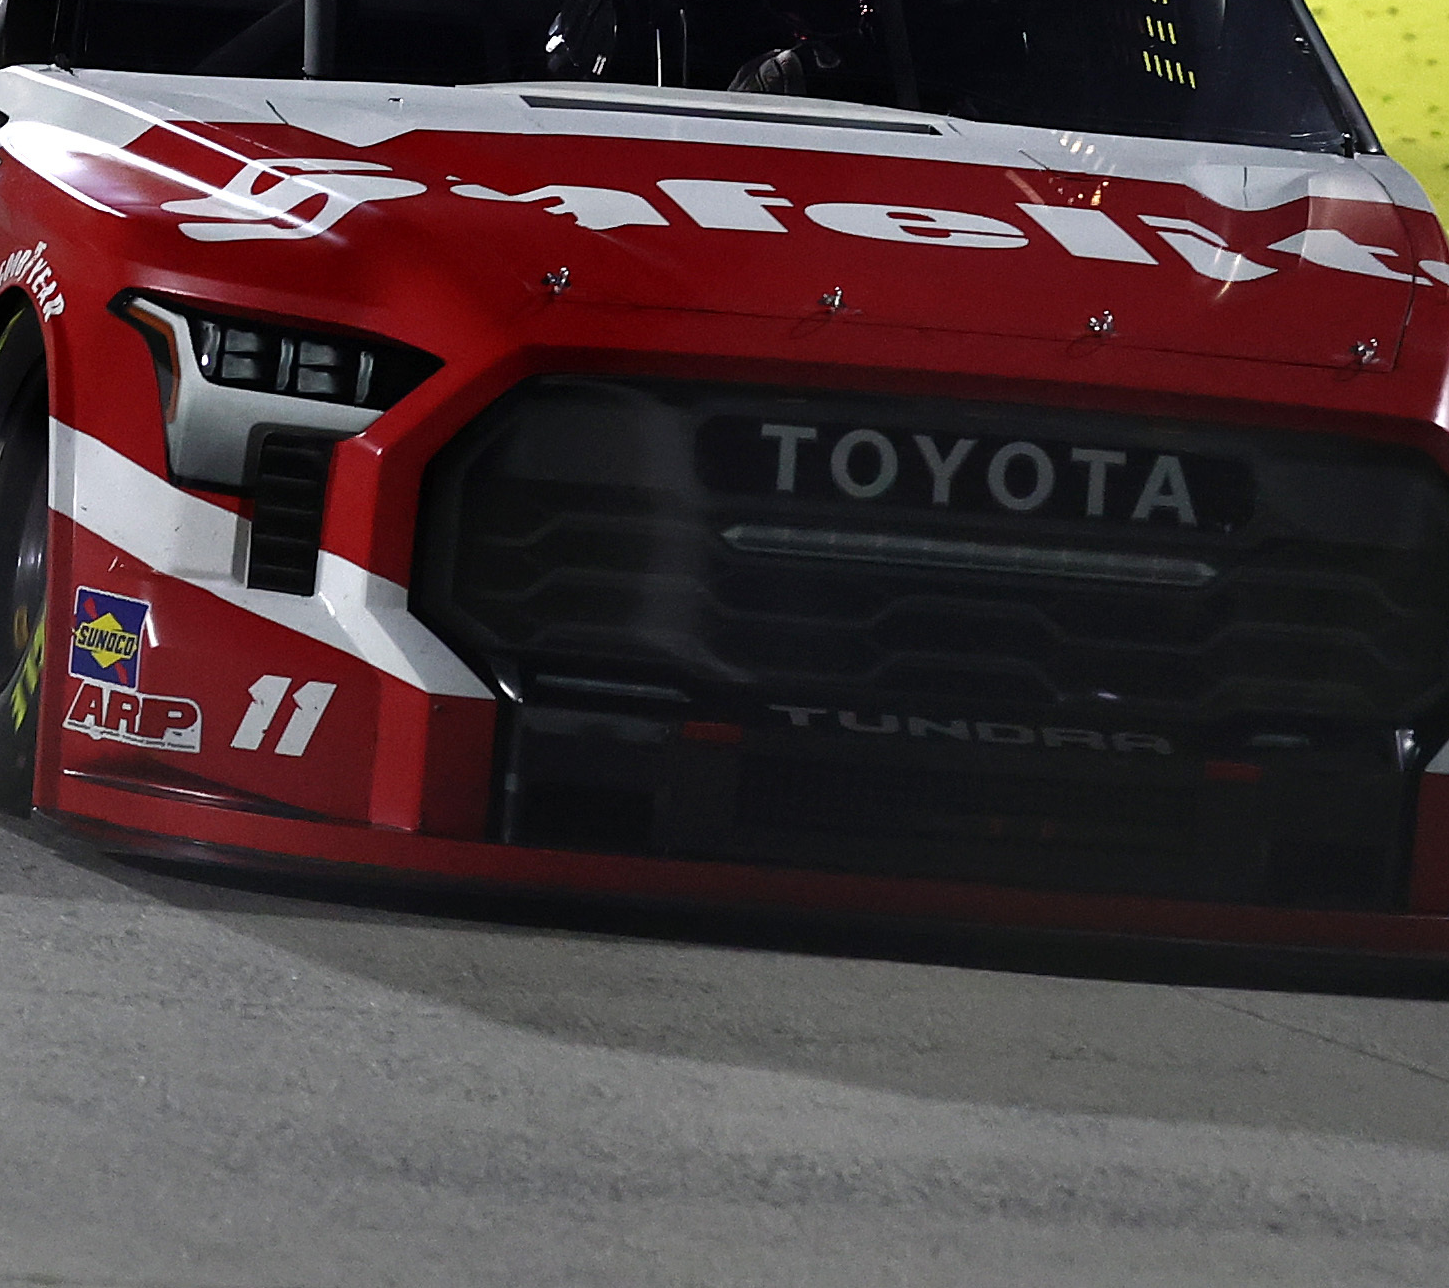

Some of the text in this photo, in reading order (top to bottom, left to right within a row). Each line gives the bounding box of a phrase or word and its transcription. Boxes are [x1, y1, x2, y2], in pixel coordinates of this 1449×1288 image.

[760, 423, 1199, 527] TOYOTA
[77, 624, 137, 658] SUNOCO
[67, 680, 200, 742] ARP
[229, 674, 339, 757] 11
[767, 702, 1174, 757] TUNDRA
